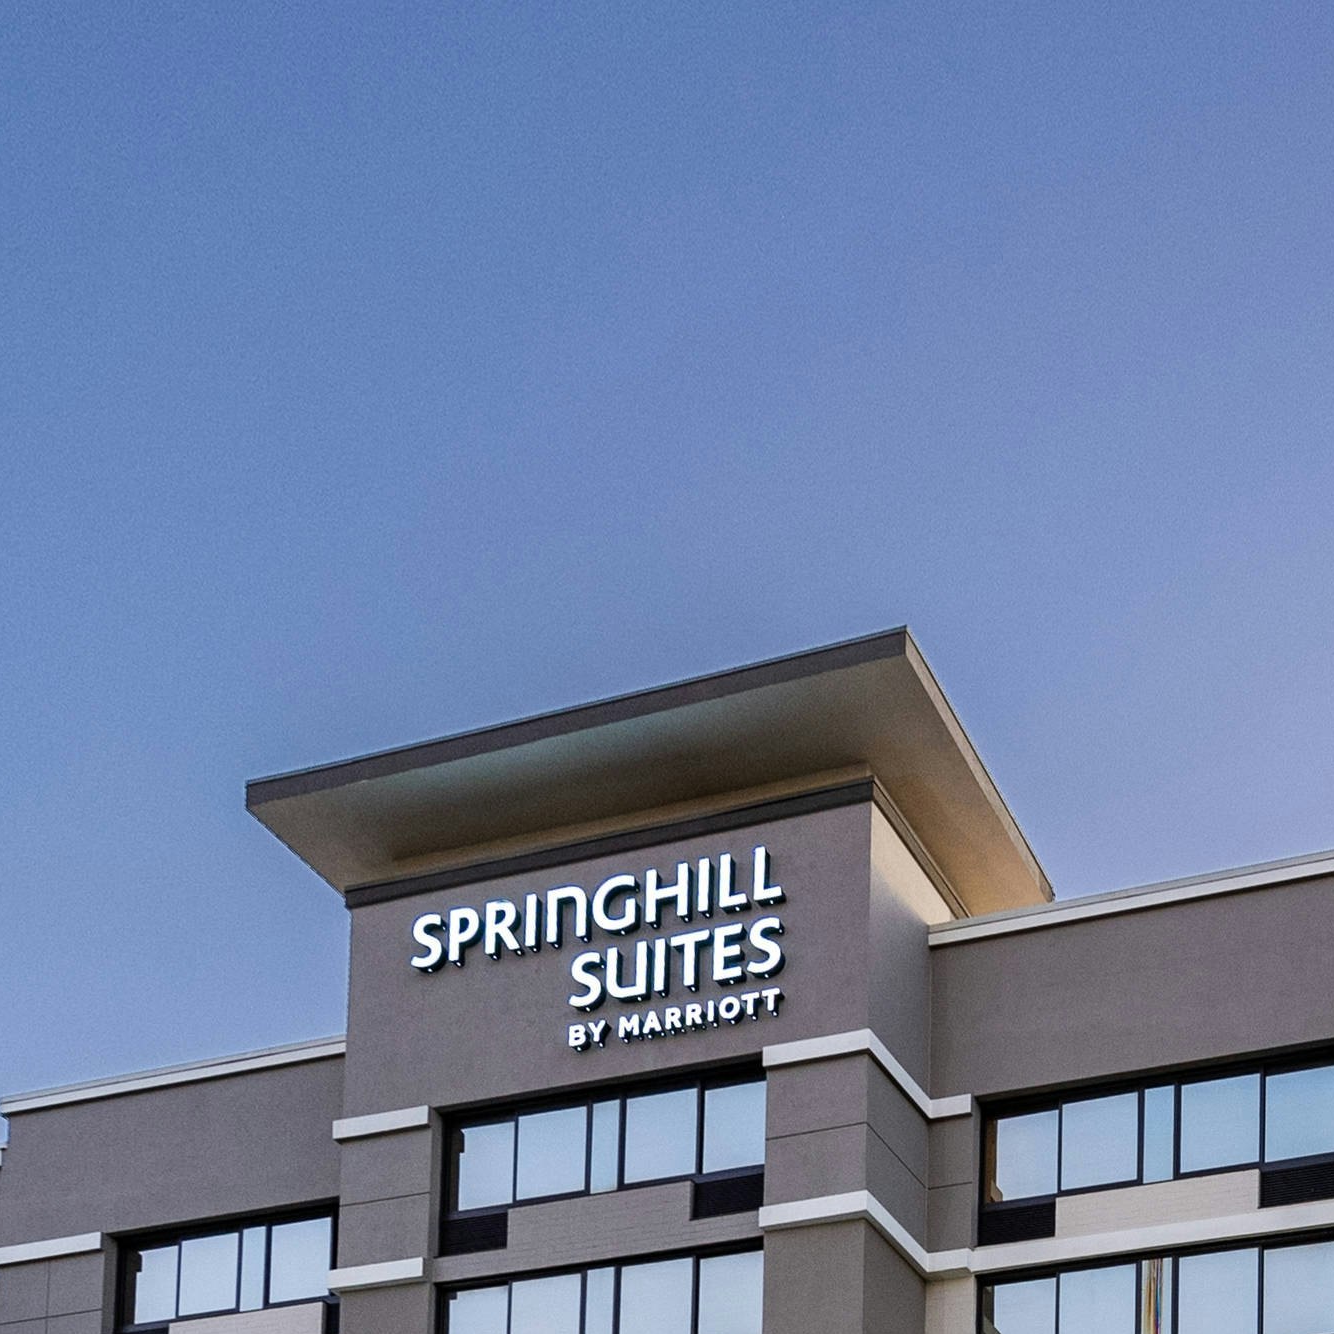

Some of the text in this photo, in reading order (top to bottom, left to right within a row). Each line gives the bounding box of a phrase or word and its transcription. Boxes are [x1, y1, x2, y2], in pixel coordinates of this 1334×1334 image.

[410, 846, 783, 968] SPRINGHILL
[569, 917, 782, 1007] SUITES
[568, 987, 782, 1047] BY MARRIOTT
